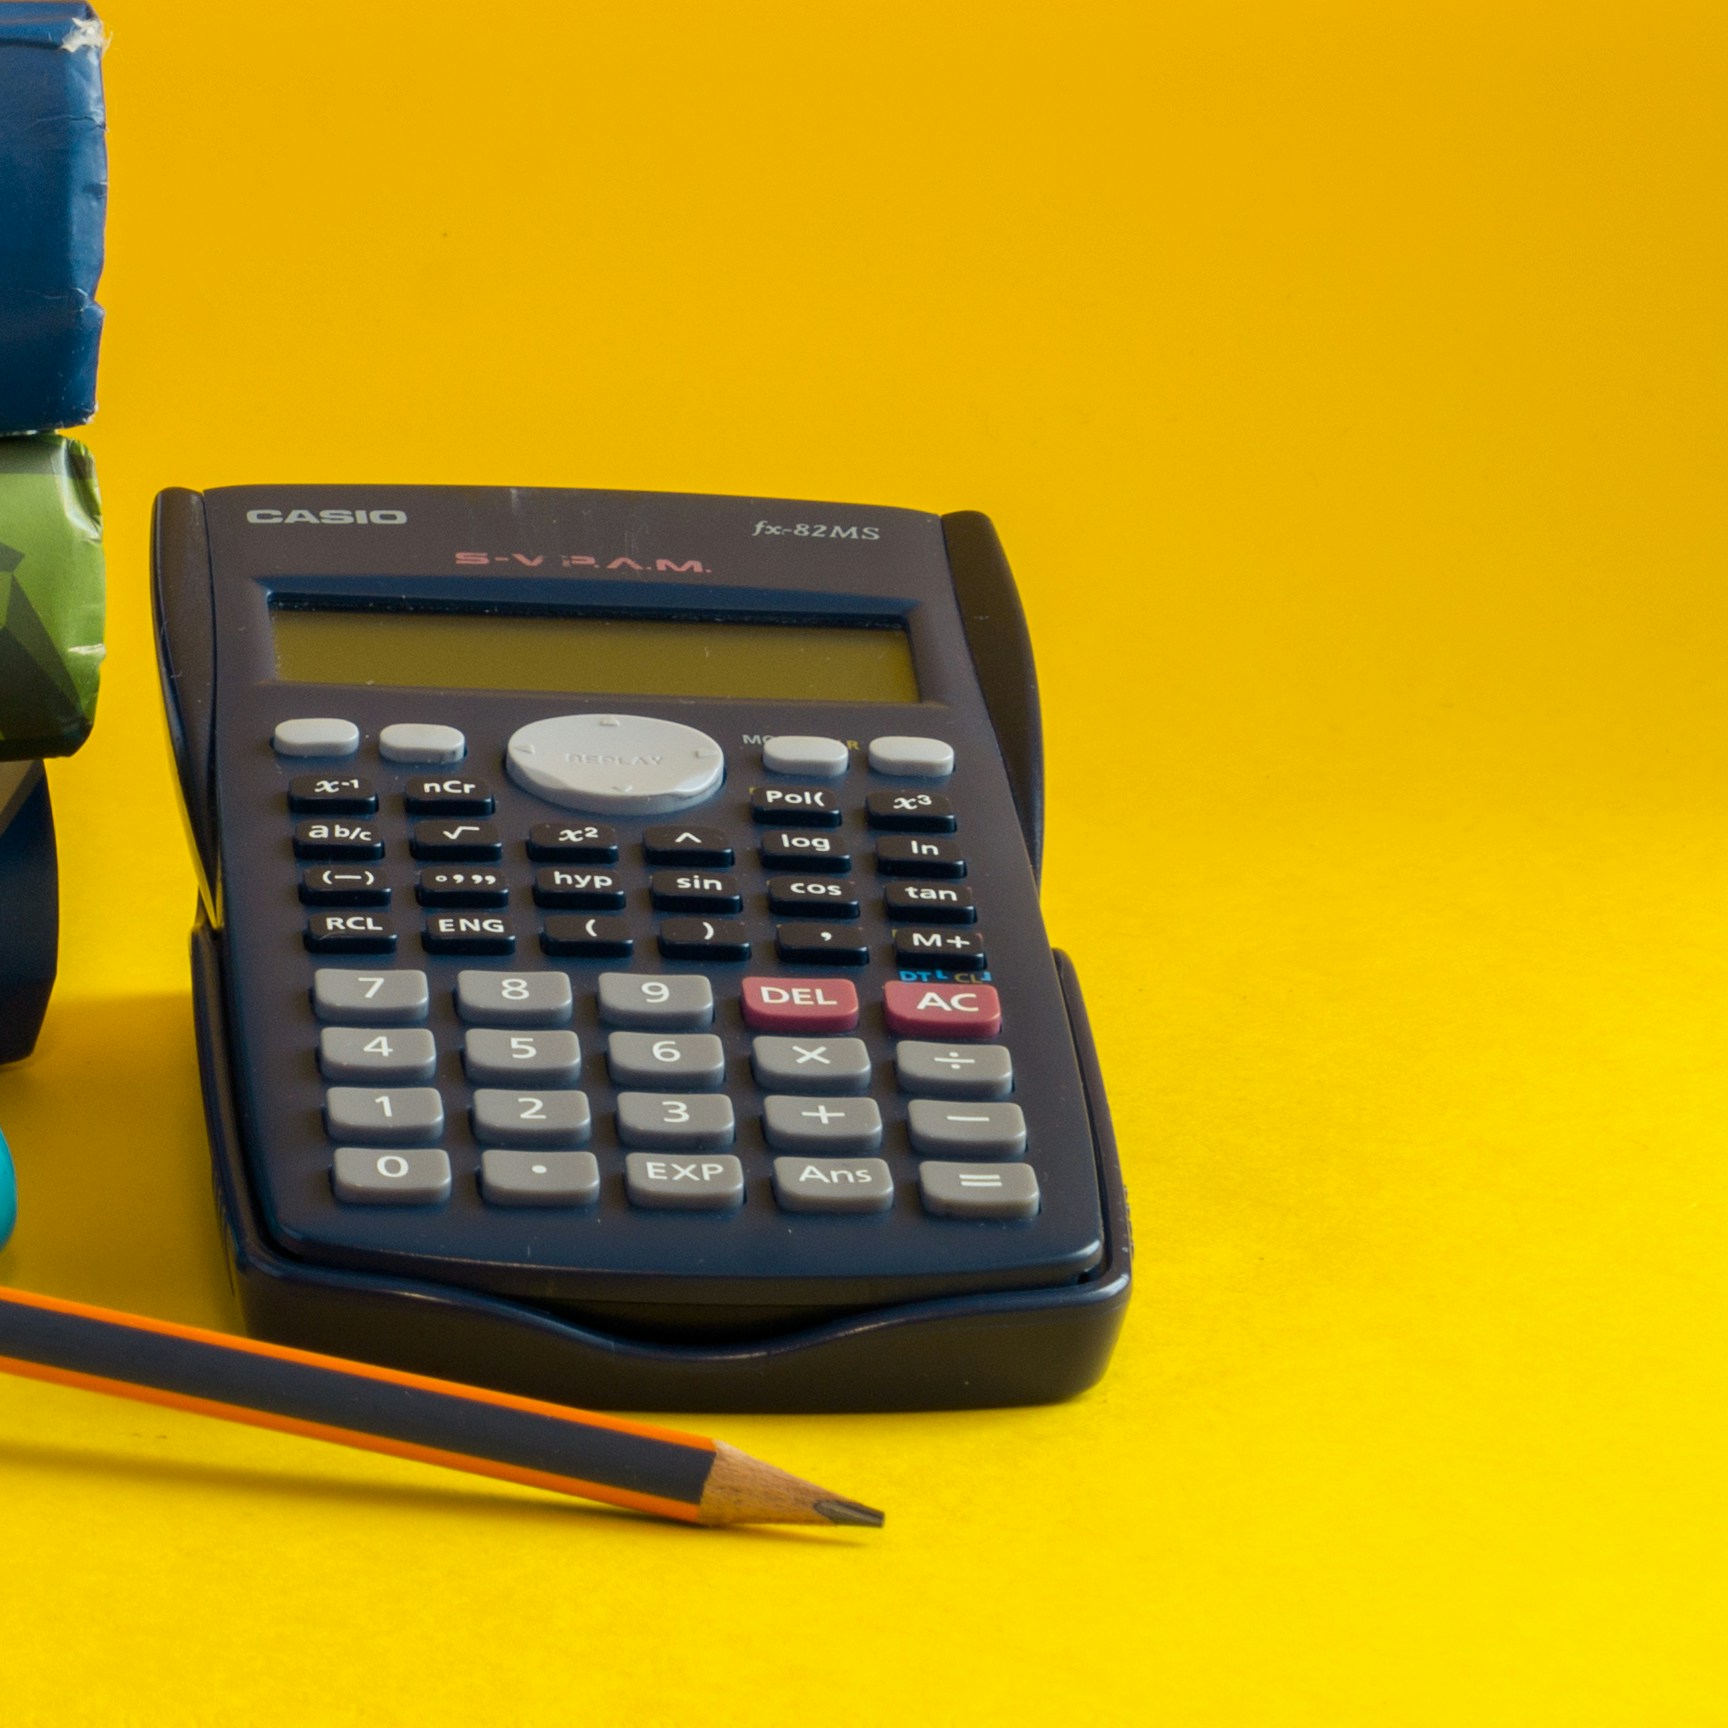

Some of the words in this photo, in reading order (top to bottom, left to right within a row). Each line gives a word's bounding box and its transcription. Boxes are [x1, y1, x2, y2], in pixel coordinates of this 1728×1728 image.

[246, 509, 408, 525] CASIO
[752, 520, 881, 541] fx-82MS
[423, 780, 476, 794] nCr
[780, 833, 831, 852] log
[910, 839, 939, 856] ln
[553, 870, 613, 889] hyp
[676, 875, 723, 891] sin
[790, 881, 843, 896] cos
[904, 885, 959, 902] tan
[325, 916, 384, 932] RCL
[438, 918, 505, 933] ENG
[912, 932, 971, 949] M+
[357, 976, 386, 999] 7
[500, 977, 531, 1001] 8
[640, 981, 671, 1004] 9
[759, 985, 838, 1006] DEL
[916, 991, 980, 1013] AC
[362, 1035, 394, 1058] 4
[509, 1036, 538, 1060] 5
[651, 1040, 682, 1063] 6
[374, 1095, 394, 1118] 1
[517, 1097, 547, 1120] 2
[661, 1100, 691, 1123] 3
[375, 1154, 410, 1178] 0
[645, 1161, 725, 1182] EXP
[797, 1164, 873, 1184] Ans
